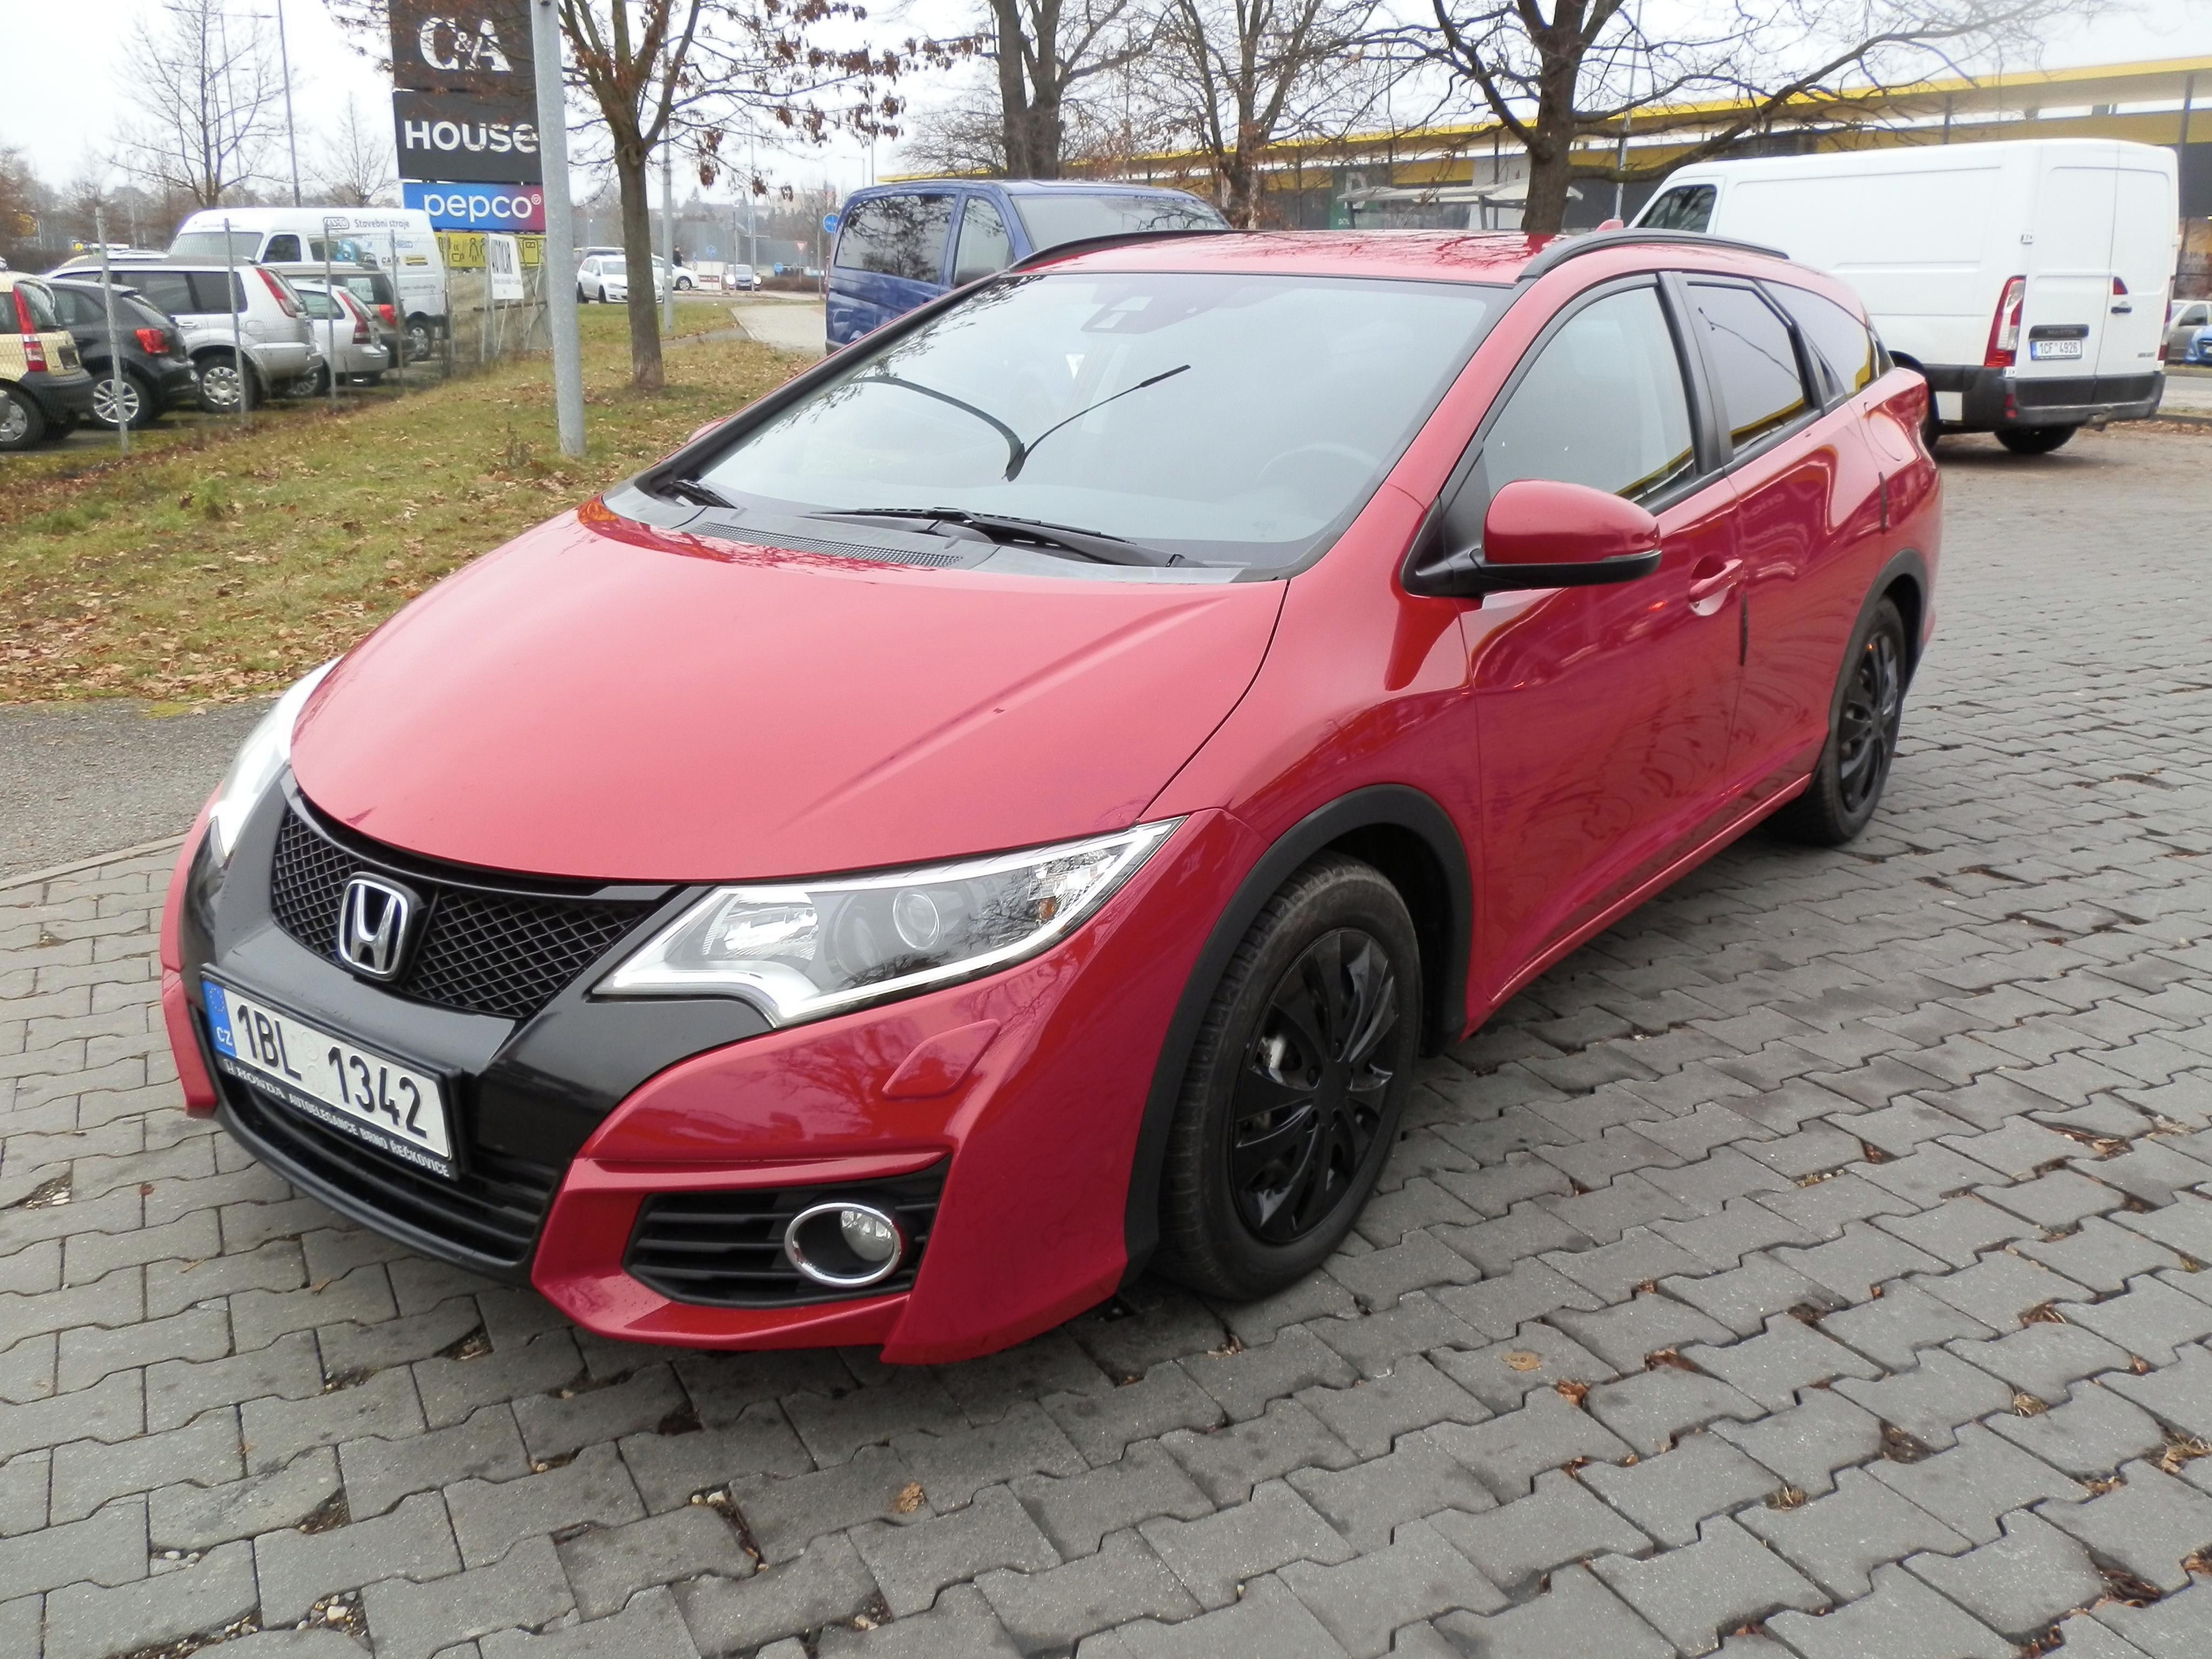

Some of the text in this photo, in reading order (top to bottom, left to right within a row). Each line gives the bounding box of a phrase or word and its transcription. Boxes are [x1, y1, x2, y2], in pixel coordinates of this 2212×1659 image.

[419, 17, 514, 72] C&A
[423, 193, 532, 222] pepco
[215, 1026, 233, 1047] CZ
[237, 1003, 427, 1139] 1BL 1342
[236, 1067, 286, 1100] HONDA
[289, 1093, 359, 1136] AUTOELEGANCE
[359, 1127, 388, 1150] BRNO
